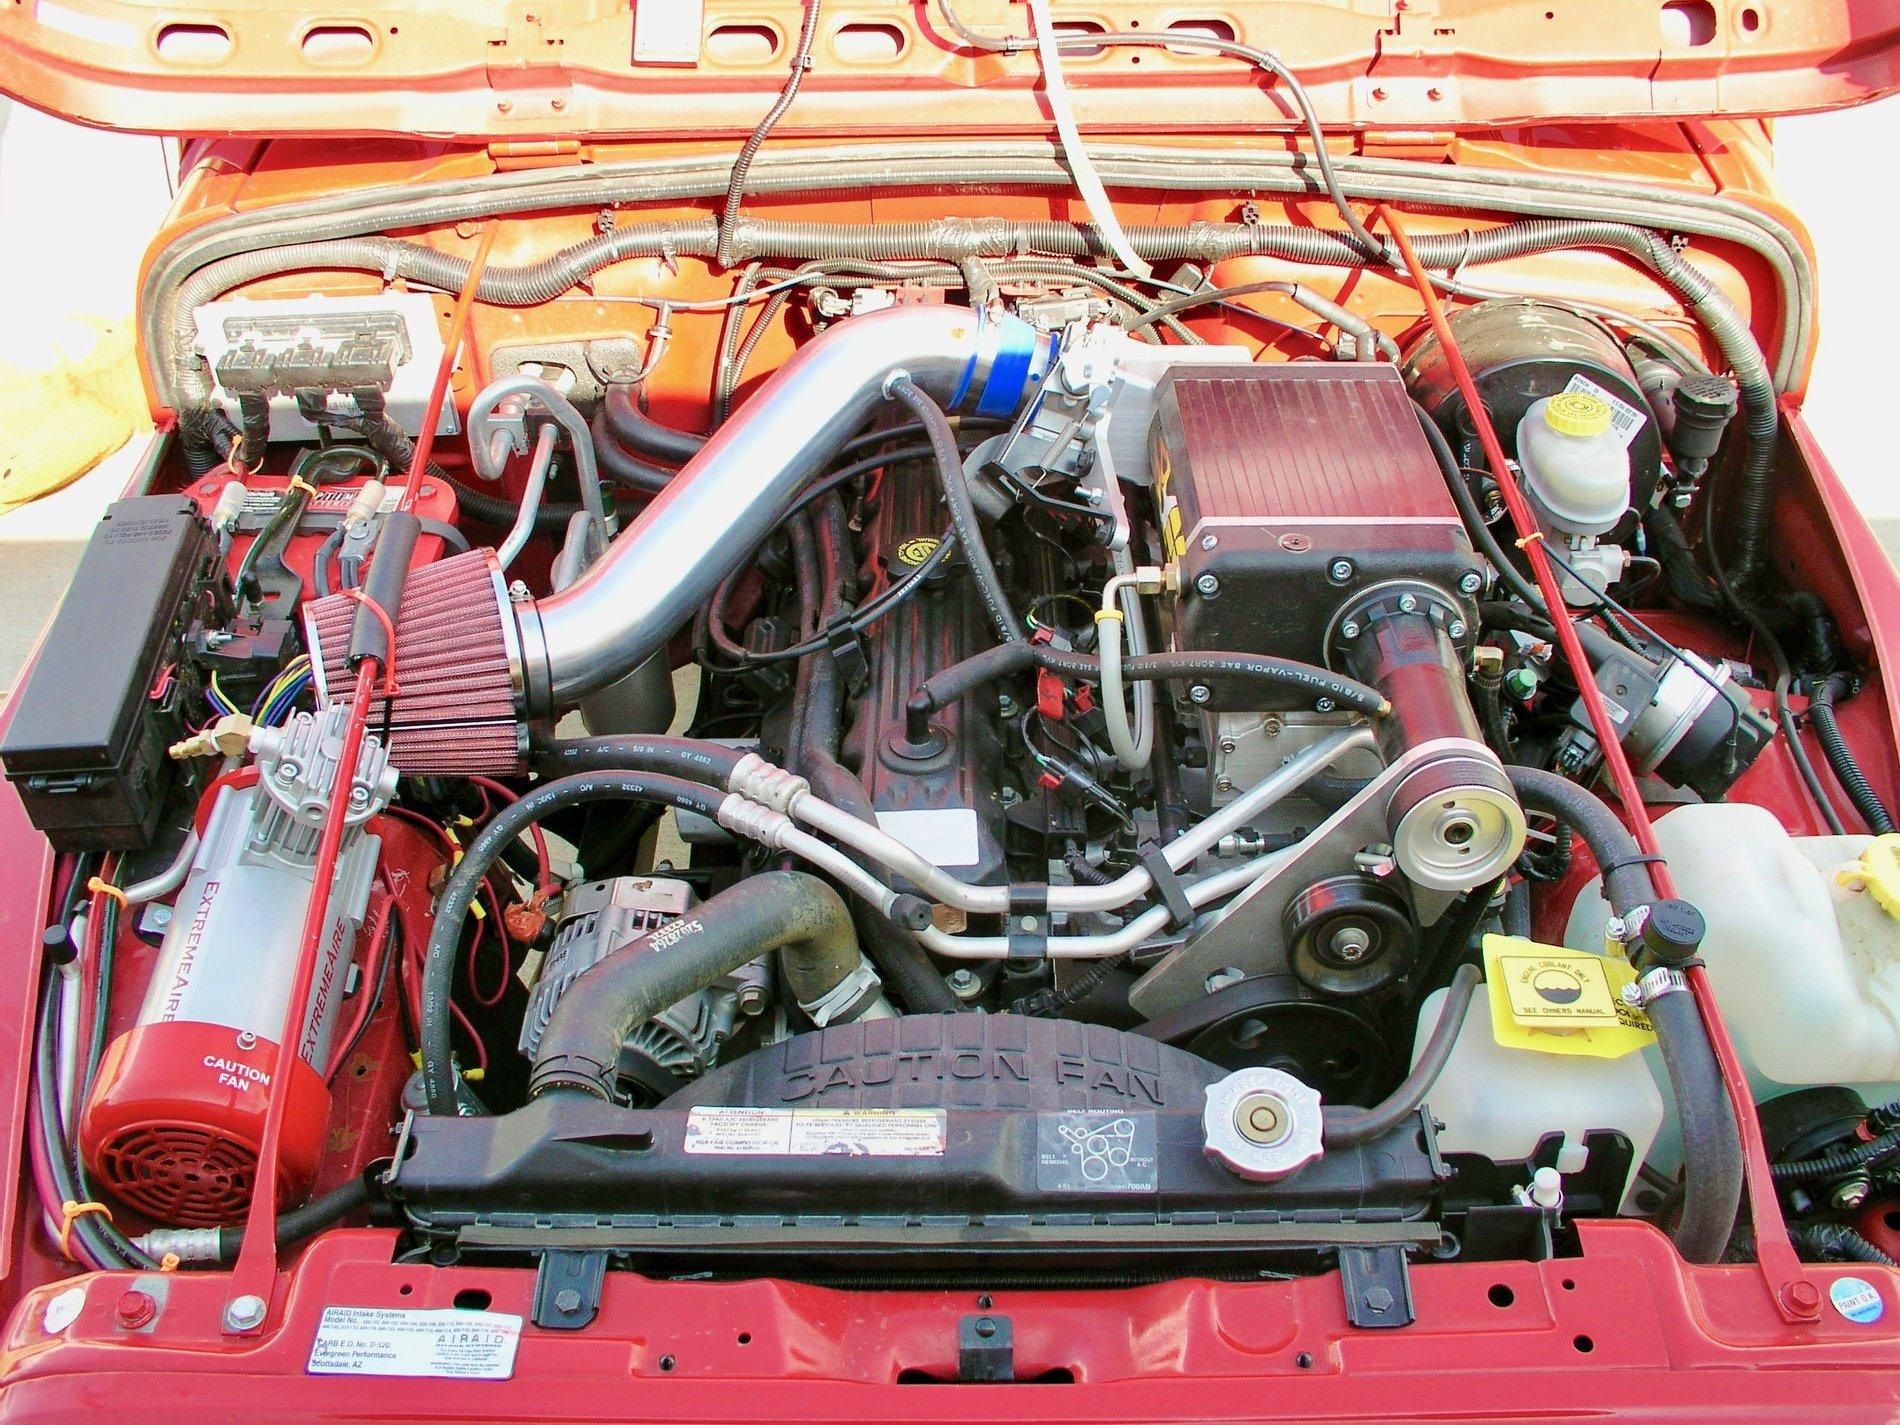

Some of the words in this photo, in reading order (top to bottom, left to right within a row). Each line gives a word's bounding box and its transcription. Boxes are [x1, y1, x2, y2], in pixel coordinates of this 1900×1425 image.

[1220, 661, 1241, 669] SAE
[1247, 663, 1326, 687] FUEL-VAPOR
[1331, 682, 1365, 702] 3/8ID
[493, 824, 504, 836] GY
[1538, 961, 1571, 970] COOLANT
[1520, 964, 1535, 984] ENGINE
[1574, 969, 1591, 983] ONLY
[301, 916, 347, 1065] EXTREMEAIRE
[1619, 1017, 1654, 1031] QUIRED
[203, 1055, 271, 1086] CAUTION
[427, 1060, 434, 1078] GY
[218, 1072, 250, 1091] FAN
[779, 1053, 1030, 1101] CAUTION
[1056, 1059, 1164, 1106] FAN
[1838, 1297, 1860, 1310] PAINT
[353, 1309, 374, 1317] Intake
[376, 1311, 406, 1319] Systems
[317, 1339, 338, 1347] CARB
[437, 1333, 504, 1344] AIRAID
[314, 1350, 350, 1358] Evergreen
[352, 1351, 396, 1359] Performance
[311, 1360, 350, 1368] Scottsdale,
[352, 1360, 363, 1368] AZ
